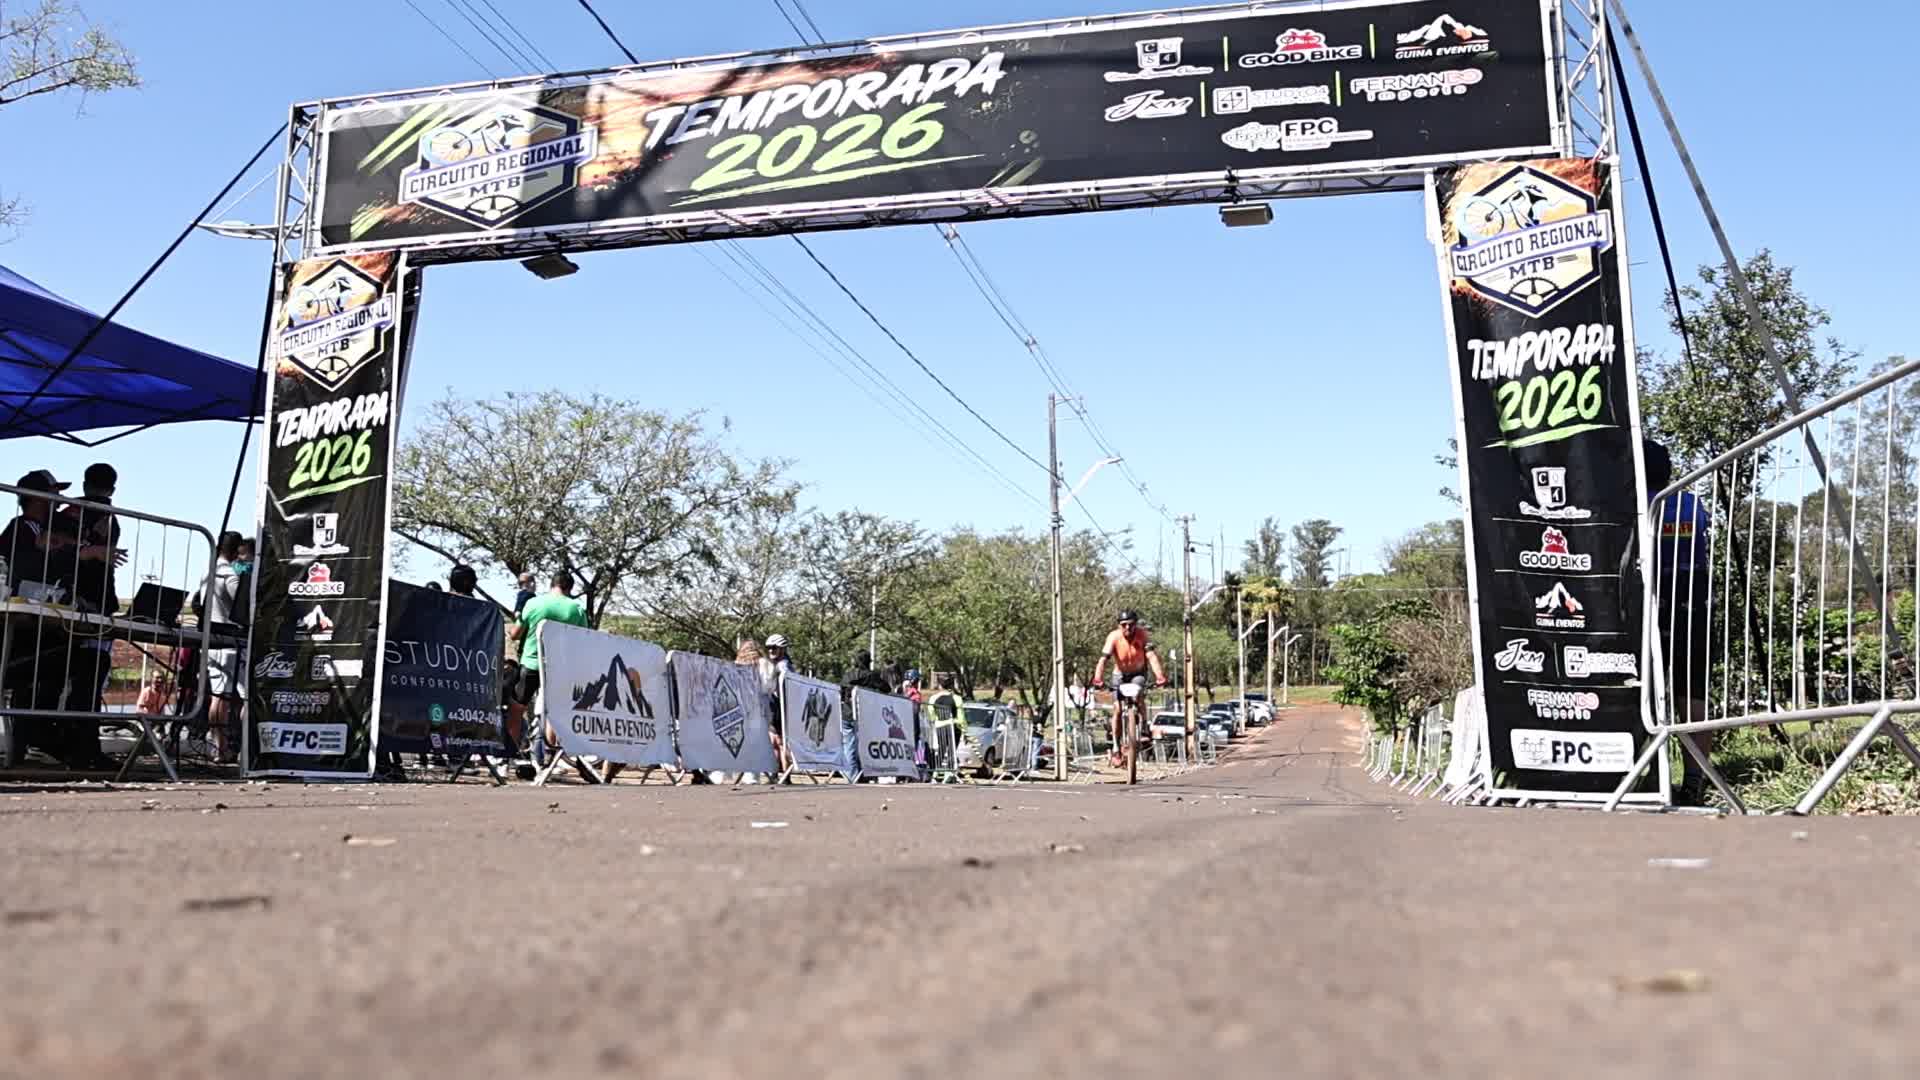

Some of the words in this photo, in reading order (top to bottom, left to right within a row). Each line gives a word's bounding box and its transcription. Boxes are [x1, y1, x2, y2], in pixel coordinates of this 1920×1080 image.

[1241, 51, 1306, 66] GOOD
[1309, 45, 1362, 61] BIKE
[1395, 49, 1433, 60] GUINA
[1436, 43, 1488, 56] EVENTOS
[644, 51, 1006, 149] TEMPORADA
[690, 102, 948, 192] 2026
[410, 161, 489, 194] CIRCUITO
[495, 137, 585, 172] REGIONAL
[469, 175, 522, 197] MTB
[1456, 236, 1524, 272] CIRCUITO
[1529, 218, 1603, 250] REGIONAL
[1509, 256, 1556, 280] MTB
[317, 338, 350, 358] MTB
[1467, 323, 1615, 381] TEMPORADA
[1498, 365, 1602, 432] 2026
[288, 429, 373, 489] 2026
[1521, 553, 1558, 567] GOOD
[1560, 555, 1590, 569] BIKE
[290, 583, 320, 595] GOOD
[390, 674, 460, 690] CONFORTO
[280, 730, 319, 749] FPC
[572, 714, 612, 736] GUINA
[615, 718, 657, 741] EVENTOS
[867, 741, 904, 760] GOOD
[1551, 740, 1593, 764] FPC
